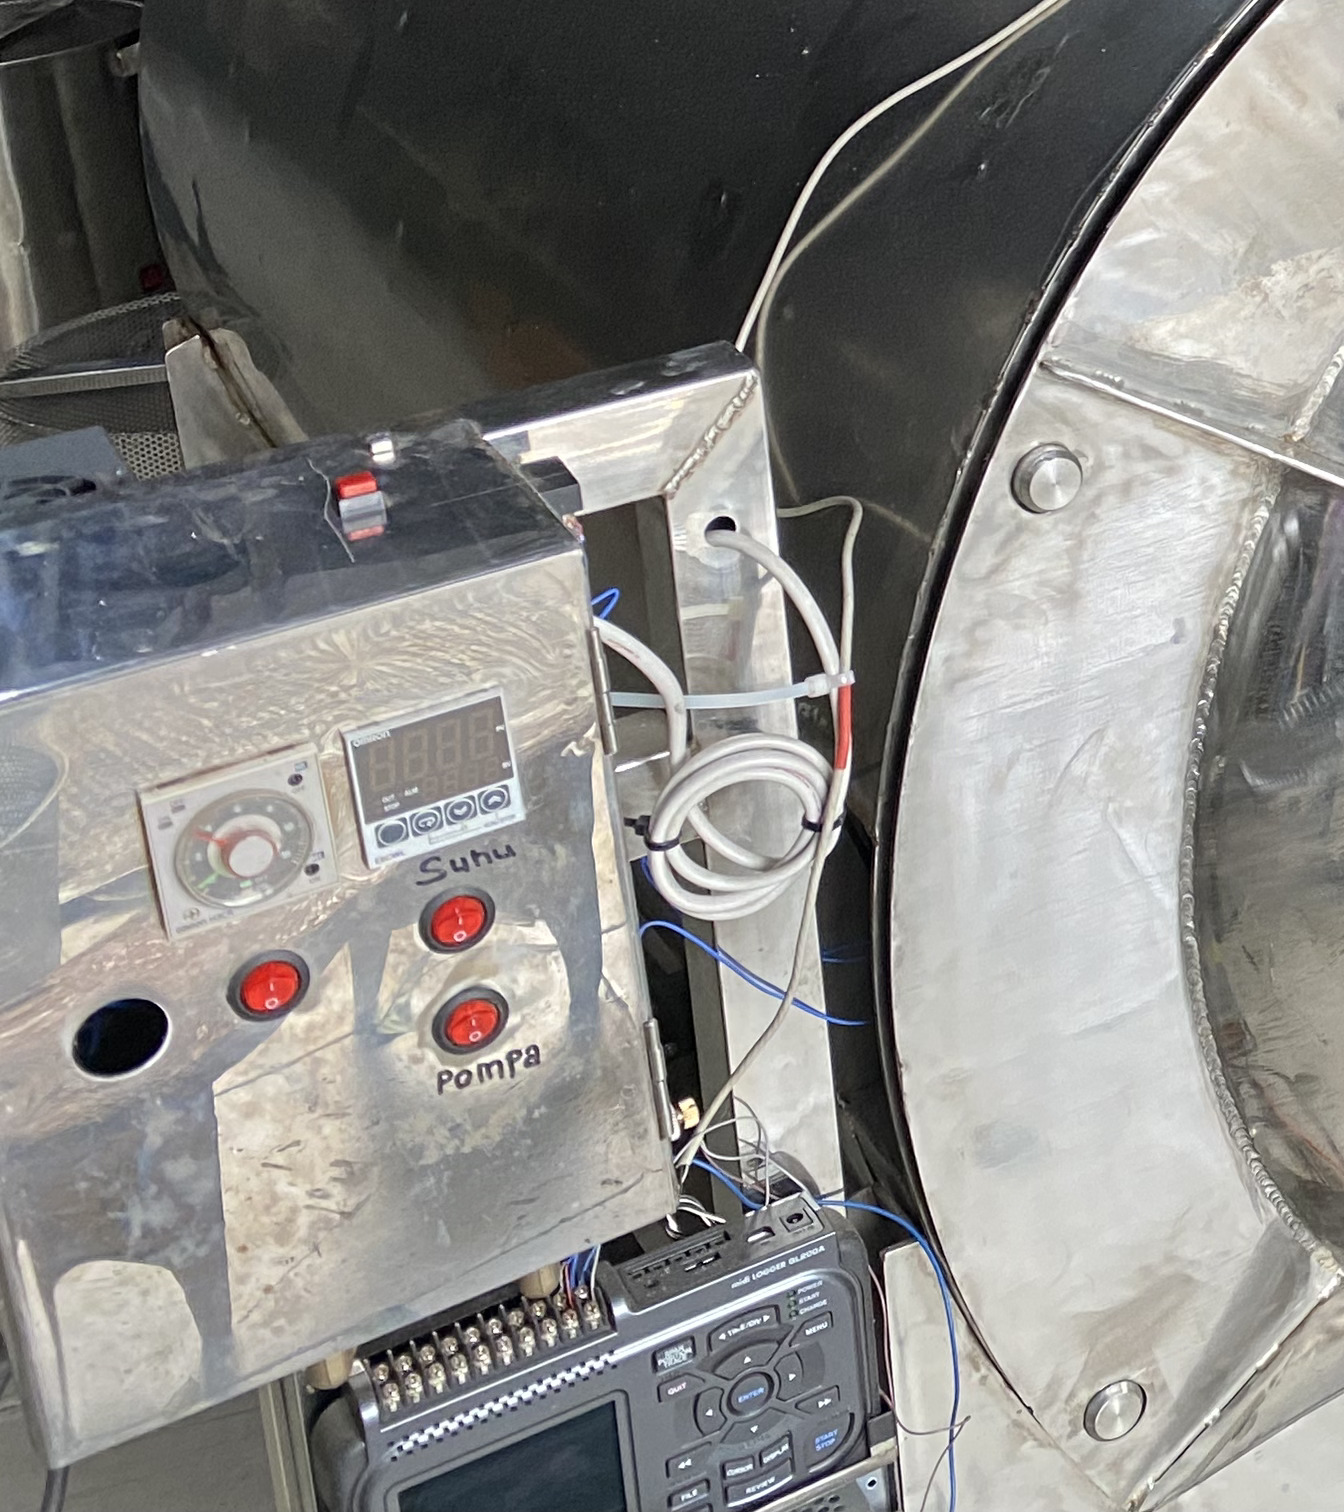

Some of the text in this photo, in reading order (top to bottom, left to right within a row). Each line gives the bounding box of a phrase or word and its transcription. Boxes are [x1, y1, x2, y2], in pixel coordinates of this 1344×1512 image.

[752, 1261, 786, 1280] LOGGER
[797, 1280, 823, 1294] POWER
[799, 1299, 827, 1315] CHARGE
[805, 1321, 828, 1336] MENU
[667, 1382, 687, 1395] QUIT
[738, 1386, 765, 1403] ENTER
[814, 1429, 838, 1444] START
[815, 1437, 836, 1452] STOP
[680, 1489, 698, 1501] FILE
